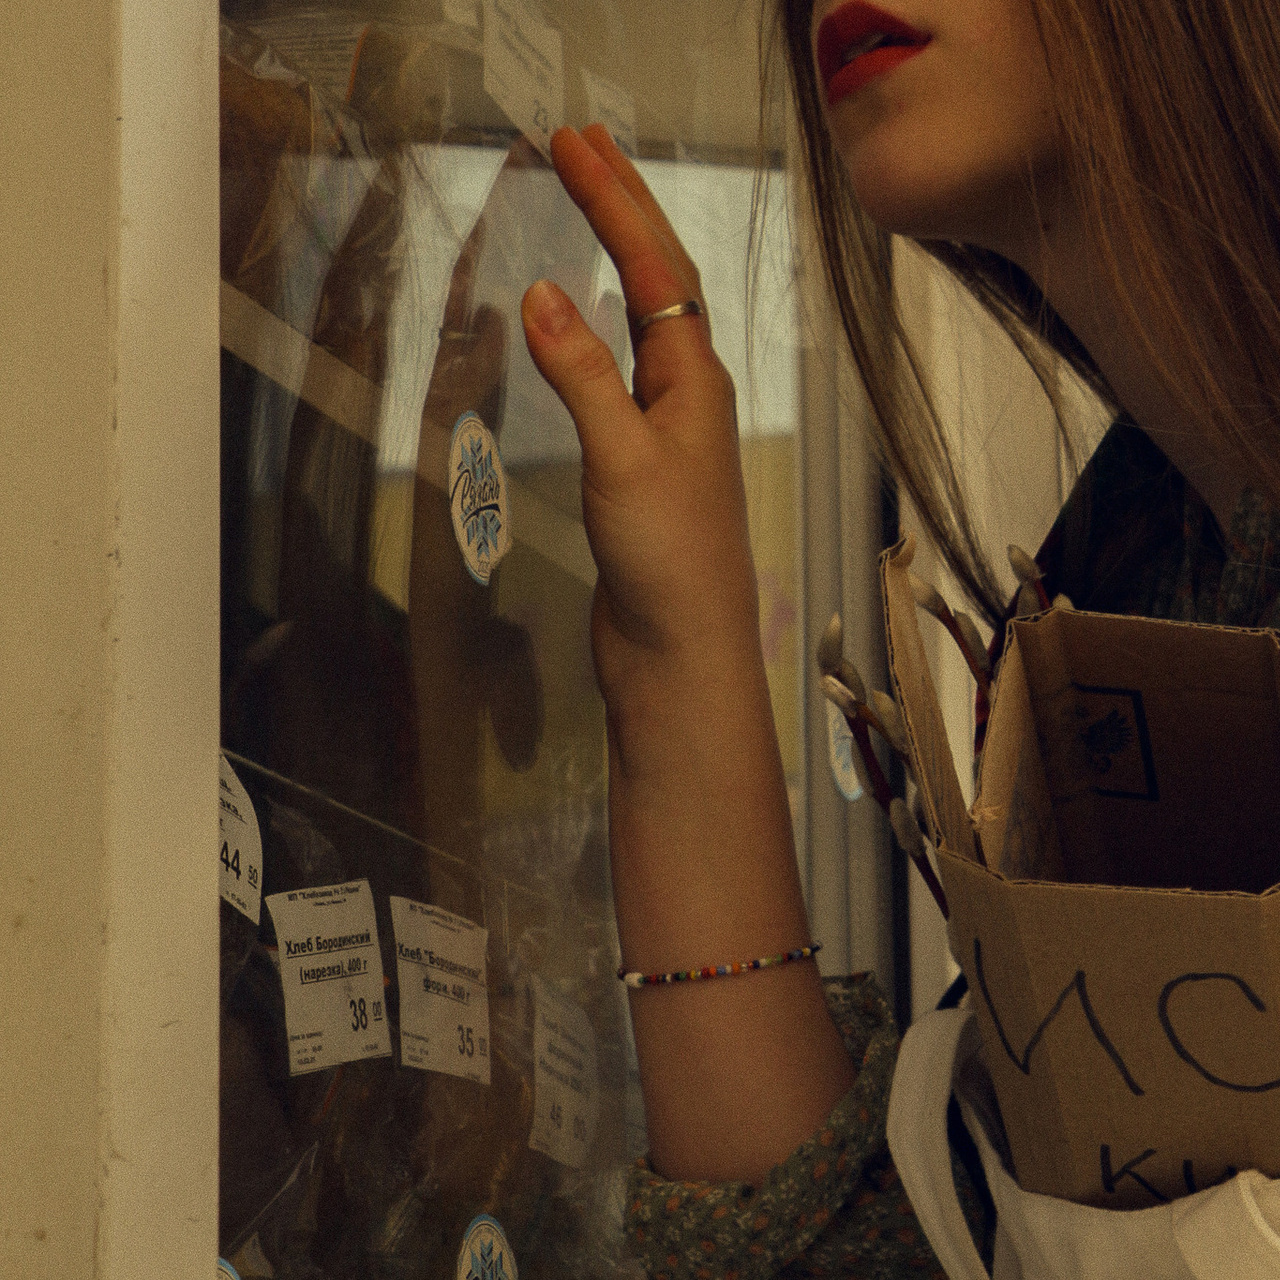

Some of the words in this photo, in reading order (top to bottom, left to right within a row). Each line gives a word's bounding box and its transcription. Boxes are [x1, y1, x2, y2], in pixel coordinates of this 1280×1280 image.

[220, 840, 241, 880] 44
[285, 937, 313, 955] Хлеб
[349, 997, 368, 1032] 38
[457, 1024, 475, 1058] 35
